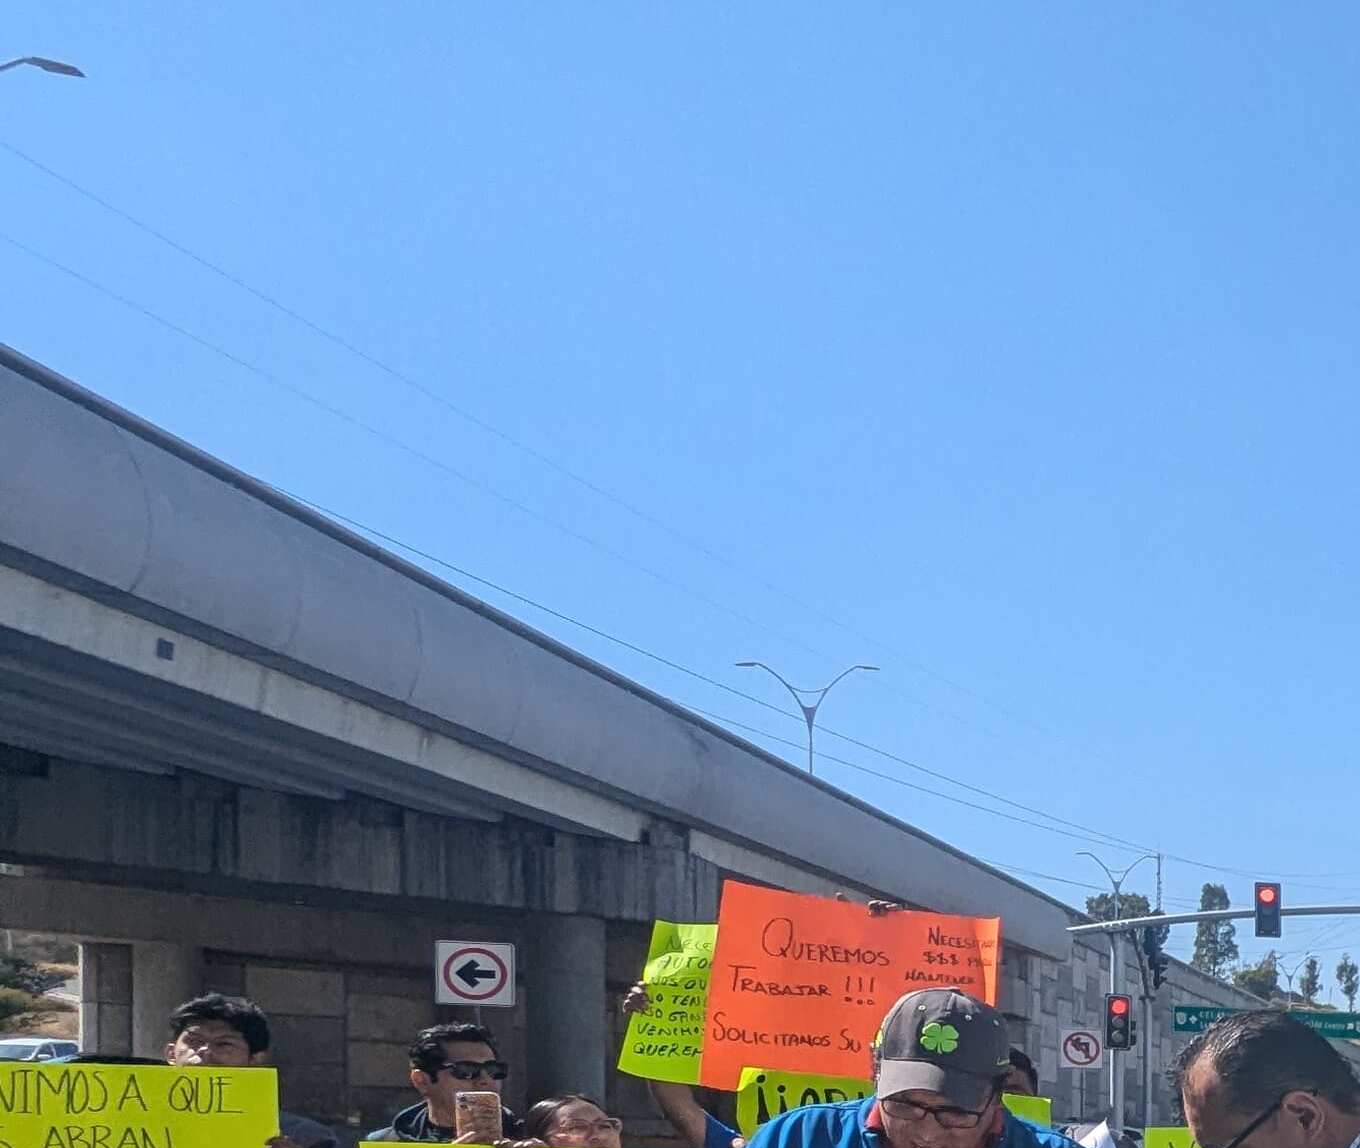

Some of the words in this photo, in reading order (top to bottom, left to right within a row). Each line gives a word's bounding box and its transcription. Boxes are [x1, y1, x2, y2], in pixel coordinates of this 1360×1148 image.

[762, 917, 890, 966] QUEREMOS
[728, 964, 831, 997] TRABAJAR
[119, 1074, 148, 1111] A
[169, 1076, 243, 1113] QUE
